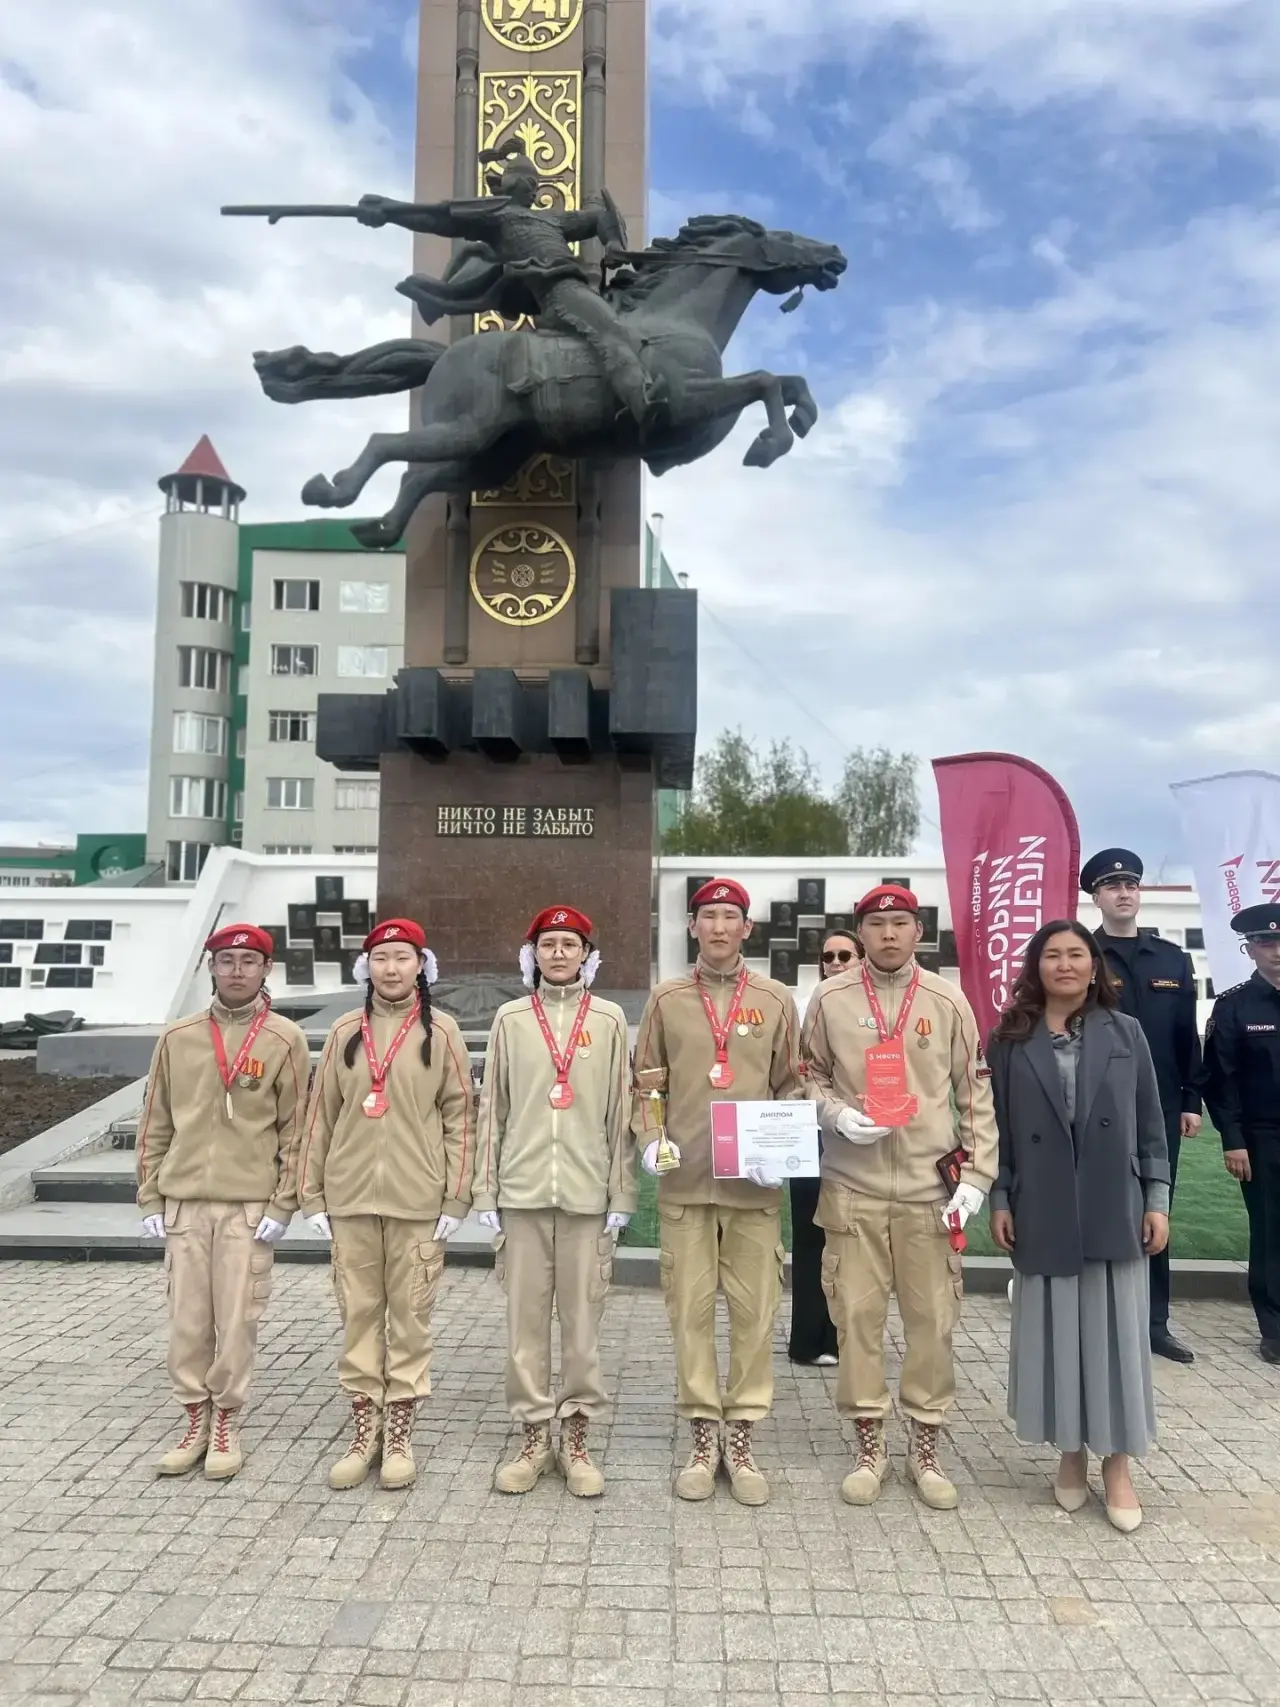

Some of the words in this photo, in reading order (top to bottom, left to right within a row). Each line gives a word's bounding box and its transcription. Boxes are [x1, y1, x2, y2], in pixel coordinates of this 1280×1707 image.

[437, 806, 496, 820] НИКТО
[502, 807, 527, 821] НЕ
[437, 821, 496, 835] НИЧТО
[502, 821, 527, 835] НЕ
[532, 822, 593, 836] ЗАБЫТО
[759, 1111, 793, 1119] ДИПЛОМ
